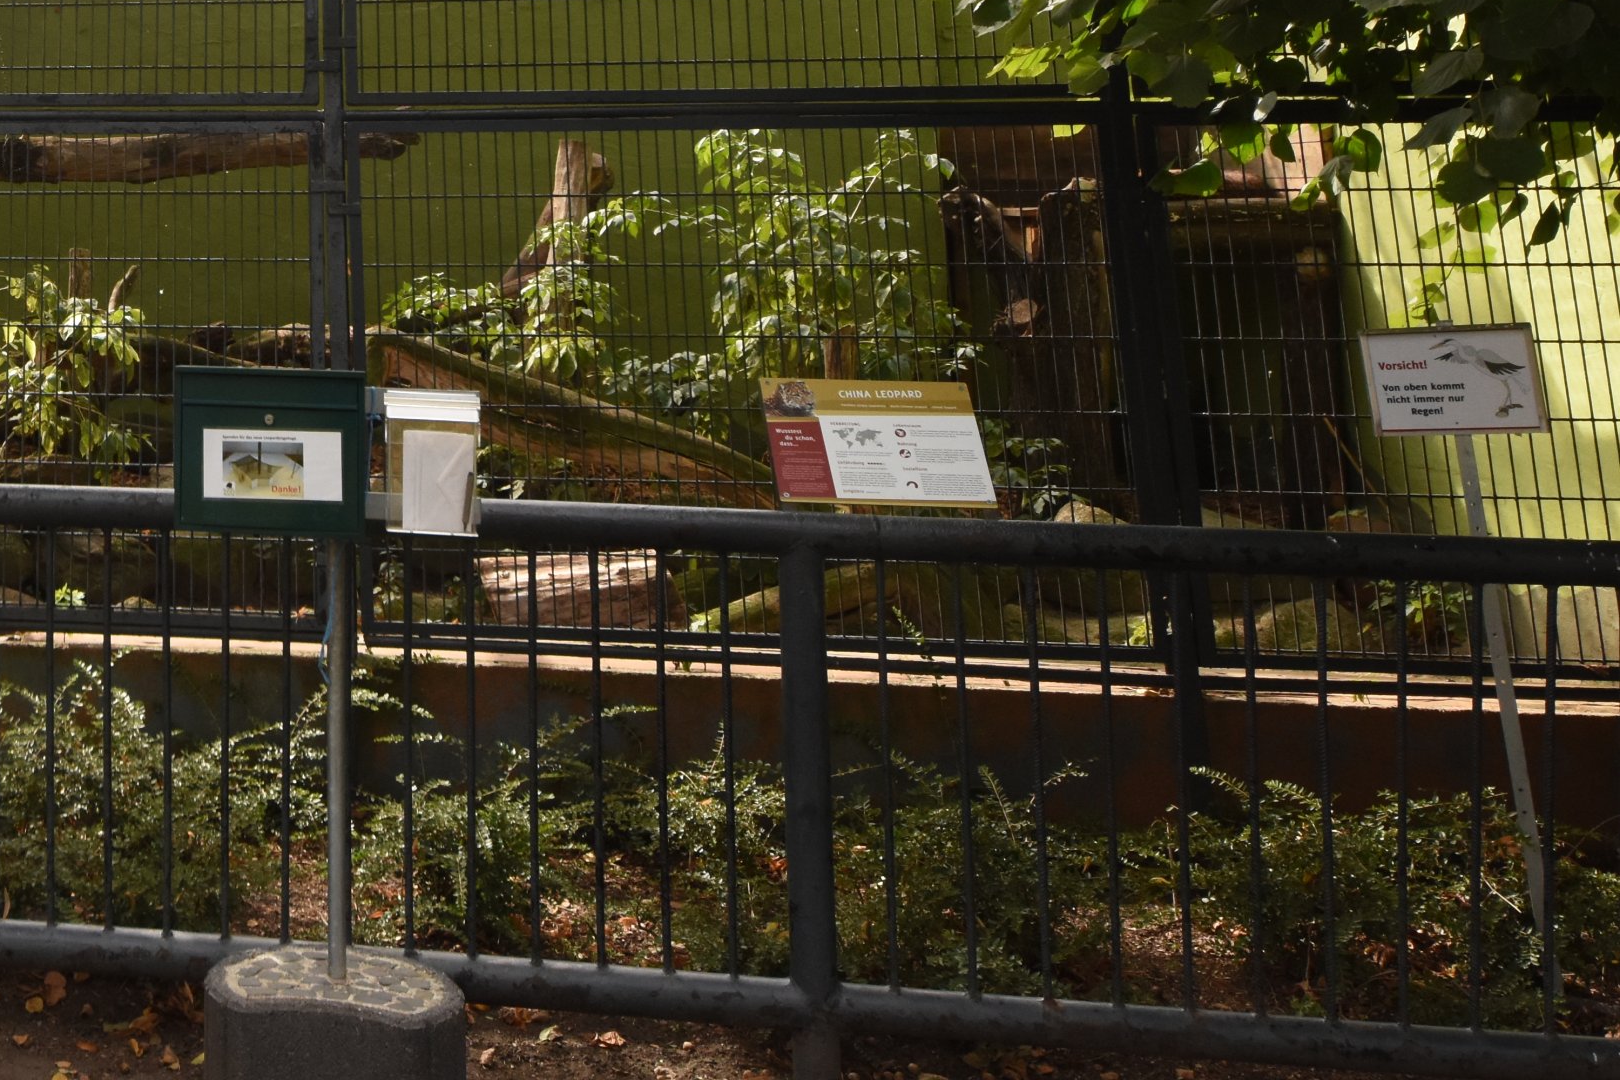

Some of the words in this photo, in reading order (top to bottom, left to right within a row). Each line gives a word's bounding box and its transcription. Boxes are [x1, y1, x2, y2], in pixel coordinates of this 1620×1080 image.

[1378, 360, 1428, 371] Vorsicht!
[1382, 384, 1400, 392] Von
[1404, 383, 1427, 391] oben
[1430, 382, 1465, 391] kommt
[838, 390, 872, 399] CHINA
[875, 390, 923, 399] LEOPARD
[1386, 395, 1410, 404] nicht
[1413, 395, 1445, 403] immer
[1448, 395, 1465, 403] nur
[1411, 407, 1444, 417] Regen!
[271, 485, 301, 493] Danke!
